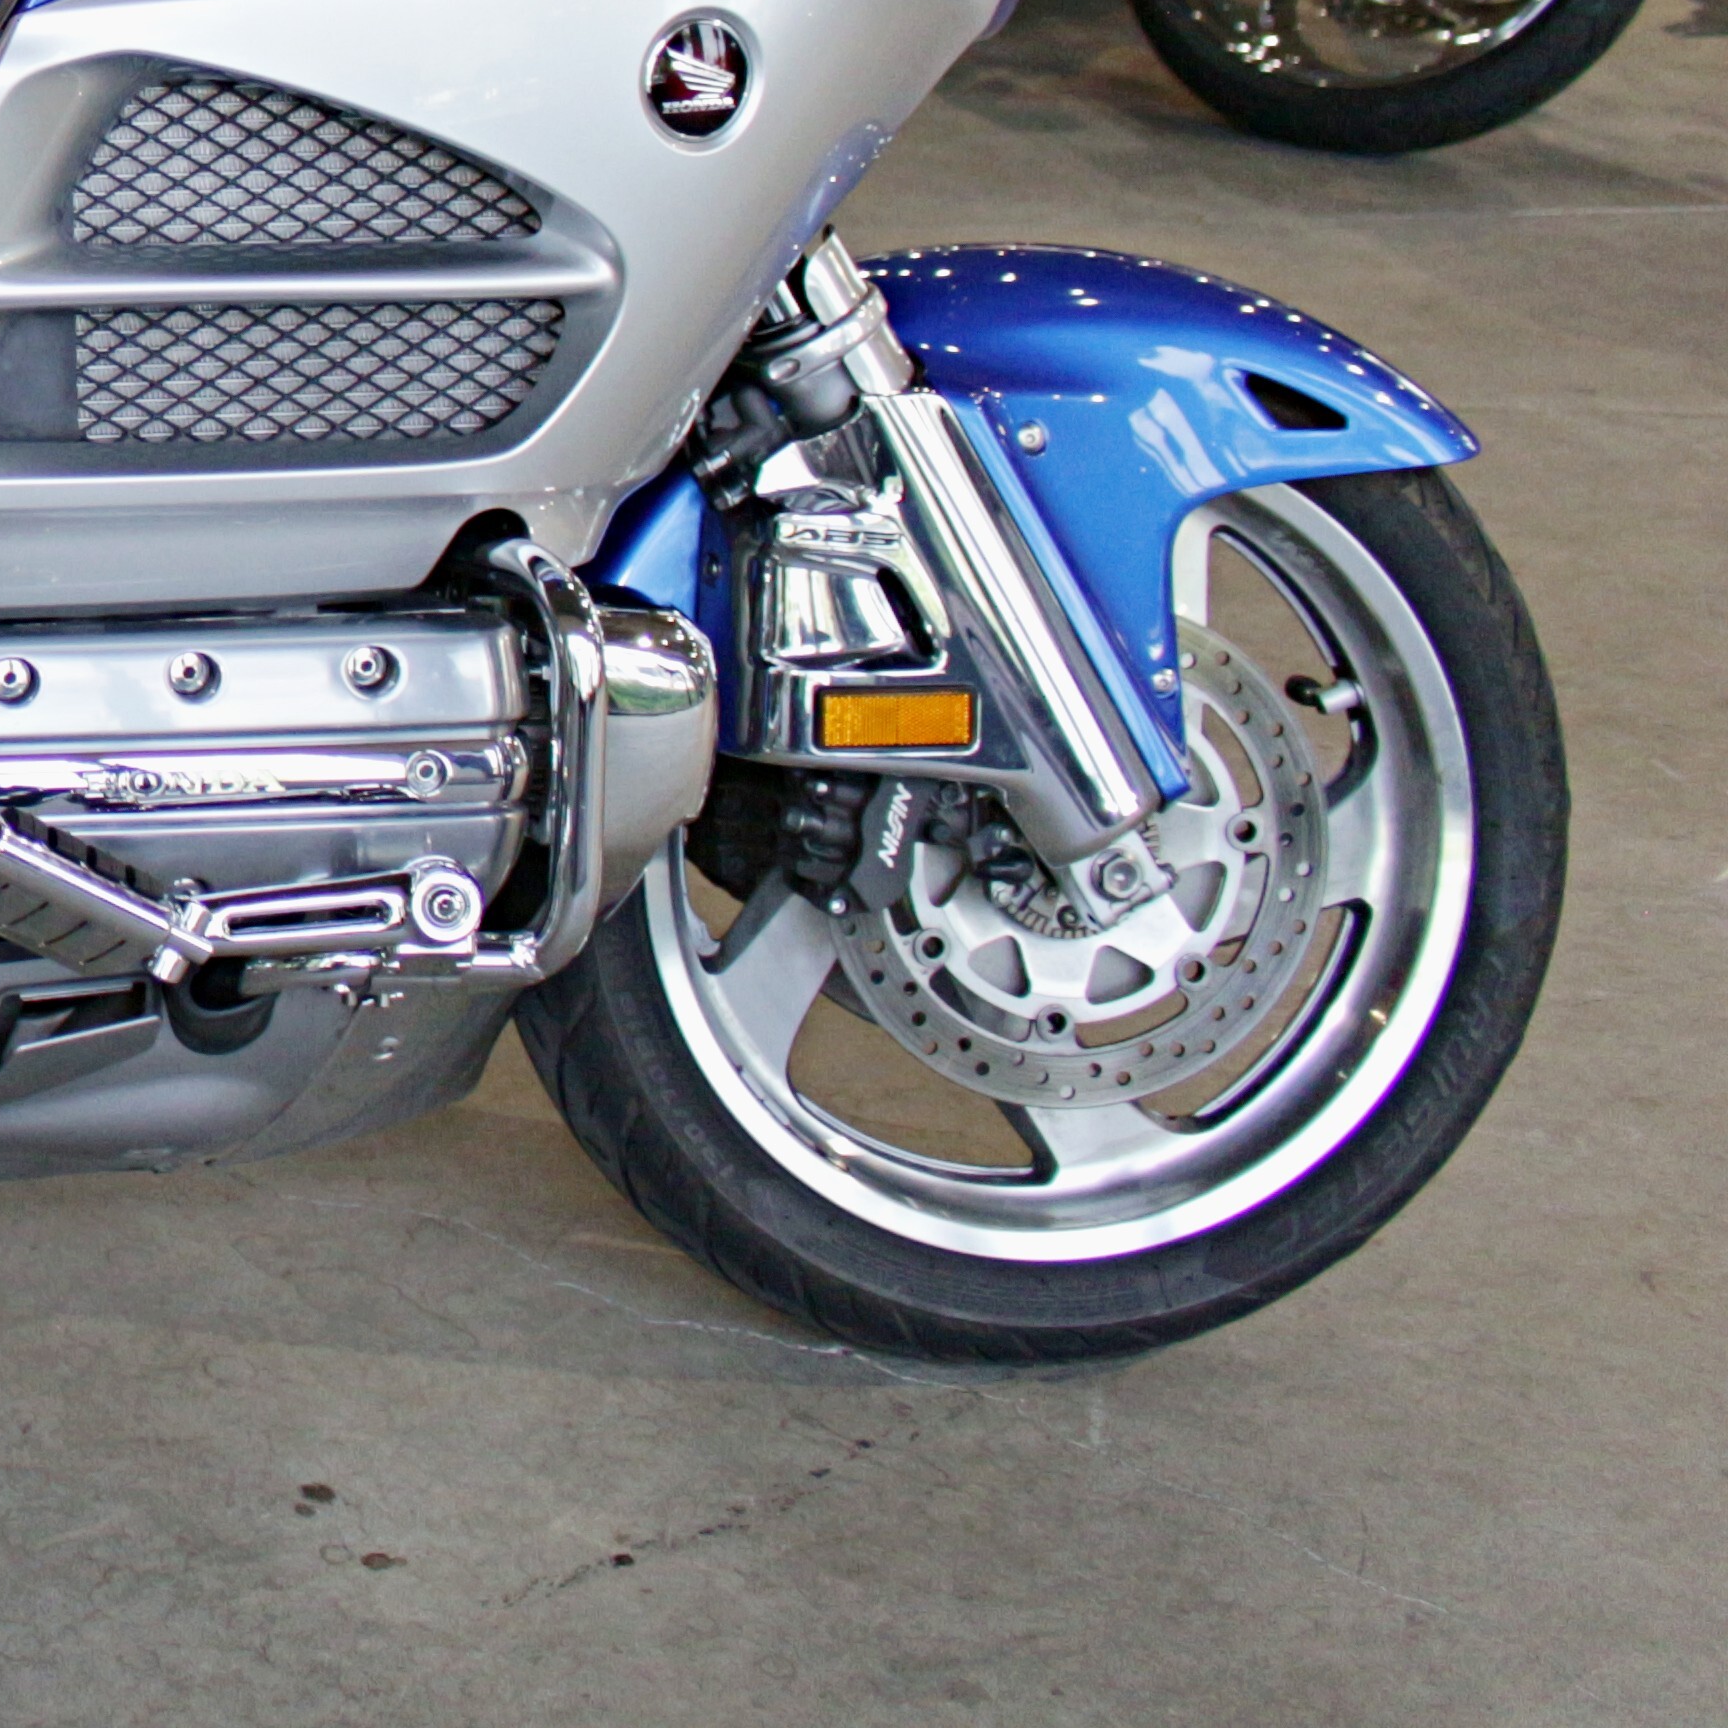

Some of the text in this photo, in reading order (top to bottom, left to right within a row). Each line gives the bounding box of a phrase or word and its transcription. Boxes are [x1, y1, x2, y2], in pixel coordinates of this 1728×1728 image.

[661, 96, 736, 116] HONDA
[82, 769, 286, 799] HONDA
[877, 780, 914, 870] NISSIN
